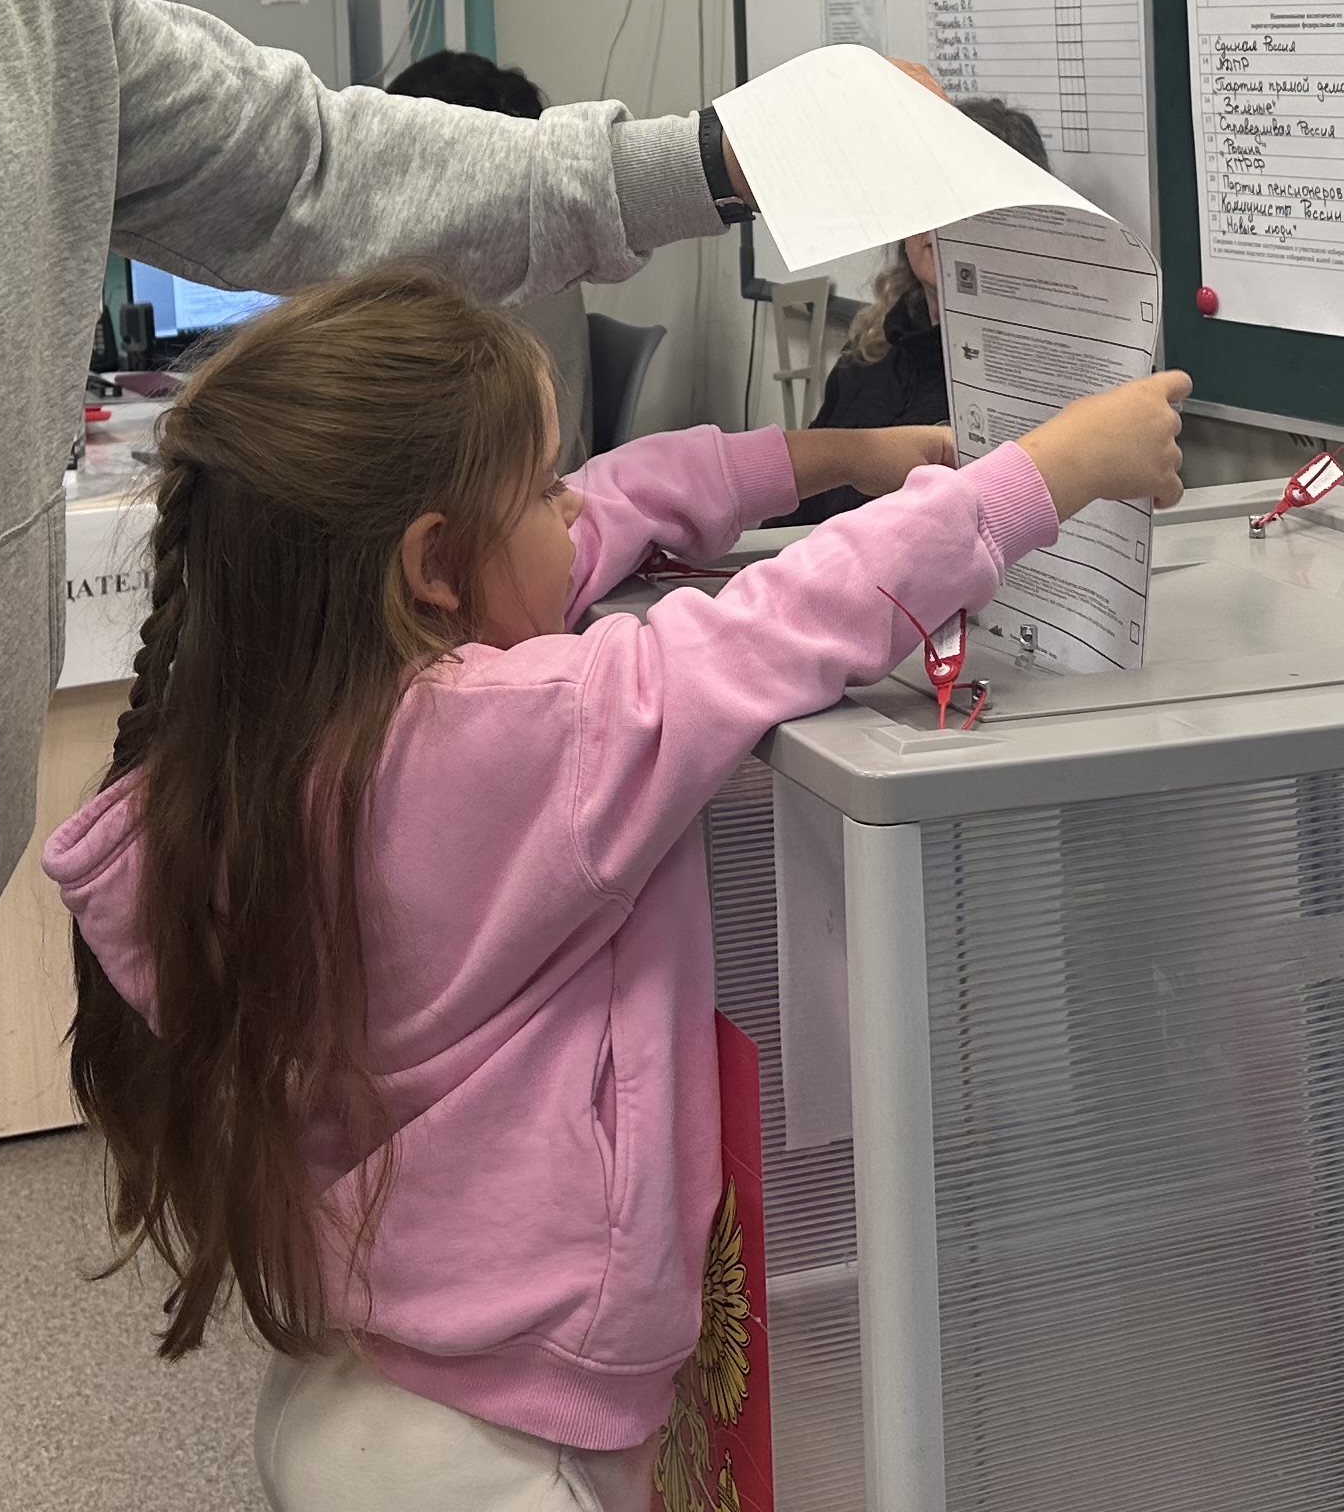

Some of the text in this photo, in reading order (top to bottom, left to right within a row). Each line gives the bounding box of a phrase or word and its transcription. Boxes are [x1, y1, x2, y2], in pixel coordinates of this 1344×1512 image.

[1215, 35, 1296, 59] Единая Россия
[1269, 77, 1309, 100] прямой
[1219, 116, 1336, 145] Справедливая Россия
[1226, 157, 1265, 175] КПРФ
[1223, 175, 1343, 207] Партия пенсионеров
[1300, 199, 1342, 221] России
